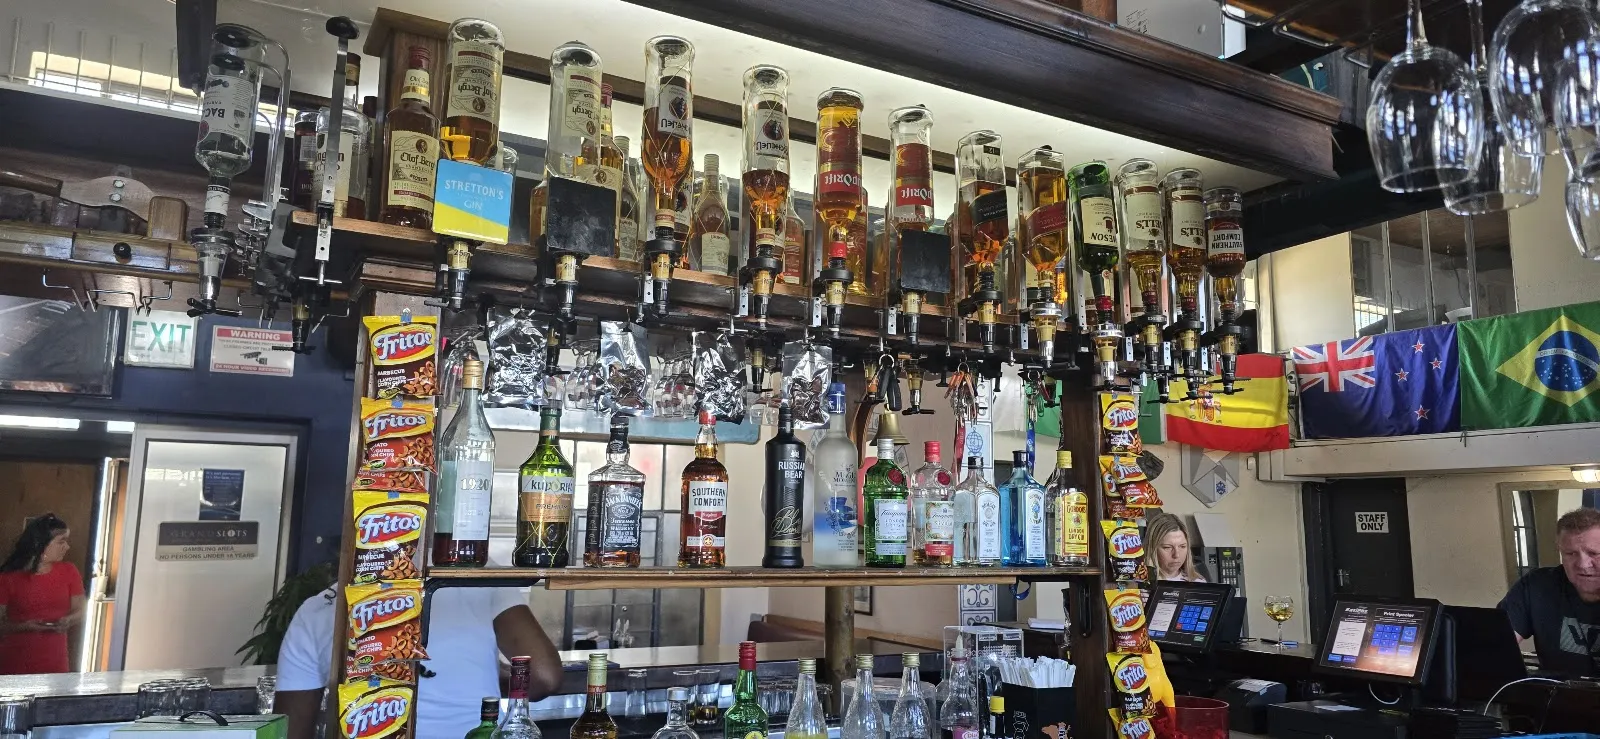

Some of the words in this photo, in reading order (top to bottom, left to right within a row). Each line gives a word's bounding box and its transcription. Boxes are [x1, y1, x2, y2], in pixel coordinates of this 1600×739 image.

[458, 83, 480, 96] Bergh
[400, 152, 419, 165] Olof
[419, 155, 435, 169] Berg
[444, 179, 504, 200] STRETTON'S
[463, 200, 483, 211] GIN
[1090, 232, 1117, 243] MESON
[1180, 227, 1204, 237] ELL'S
[1213, 233, 1241, 242] COMFORT
[1211, 241, 1243, 249] SOUTHERN
[131, 320, 192, 354] EXIT
[230, 329, 281, 341] WARNING
[373, 332, 433, 360] Fritos
[364, 413, 427, 438] Fritos
[784, 470, 803, 479] BEAR
[460, 478, 489, 491] 1920
[691, 487, 726, 497] SOUTHERN
[605, 496, 620, 508] JACK
[620, 494, 643, 508] DANIEL'S
[693, 497, 724, 507] COMFORT
[1357, 513, 1386, 522] STAFF
[358, 513, 421, 544] Fritos
[1360, 522, 1384, 531] ONLY
[215, 529, 248, 538] SLOTS
[352, 595, 415, 631] Fritos
[1110, 604, 1142, 628] Fritos
[345, 698, 408, 739] Fritos
